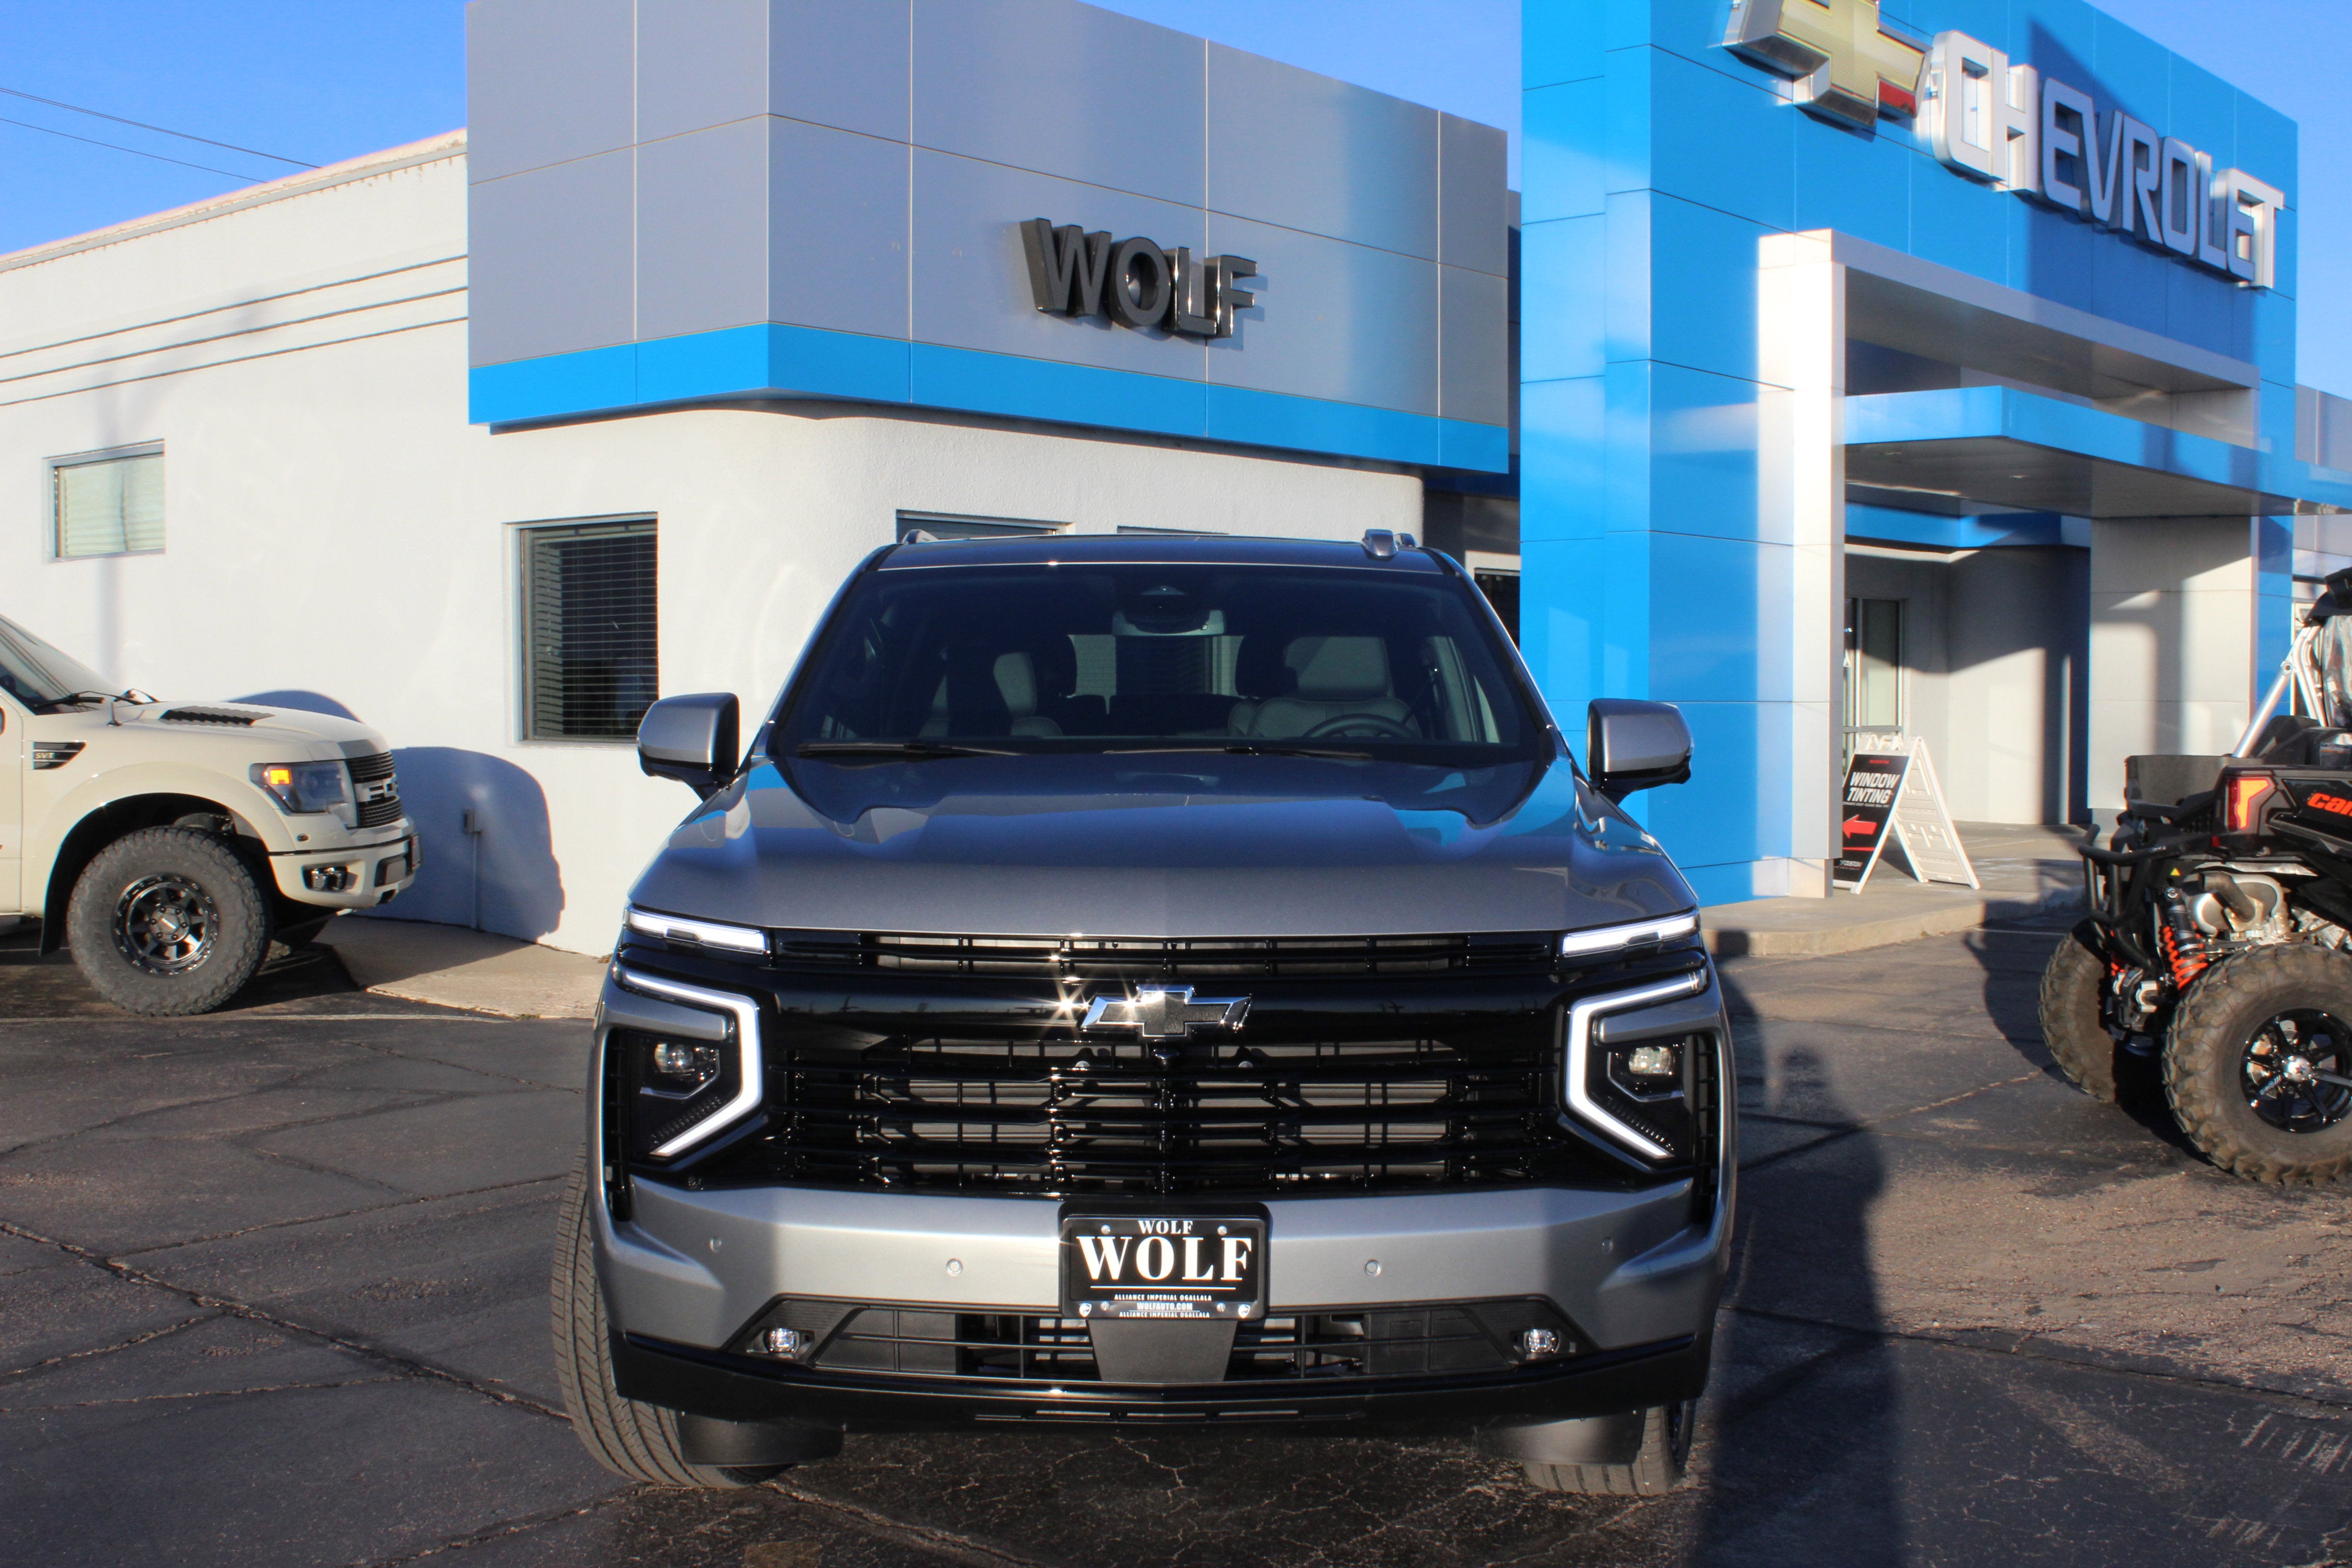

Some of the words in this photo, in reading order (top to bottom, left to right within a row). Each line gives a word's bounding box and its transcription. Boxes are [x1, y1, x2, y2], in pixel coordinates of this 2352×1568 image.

[1931, 29, 2285, 289] CHEVROLET
[1019, 218, 1258, 338] WOLF
[1850, 771, 1900, 789] WINDOW
[1847, 787, 1891, 804] TINTING
[1138, 1220, 1193, 1235] WOLF
[1076, 1235, 1252, 1281] WOLF
[1137, 1302, 1193, 1310] WOLFAUTO.COM
